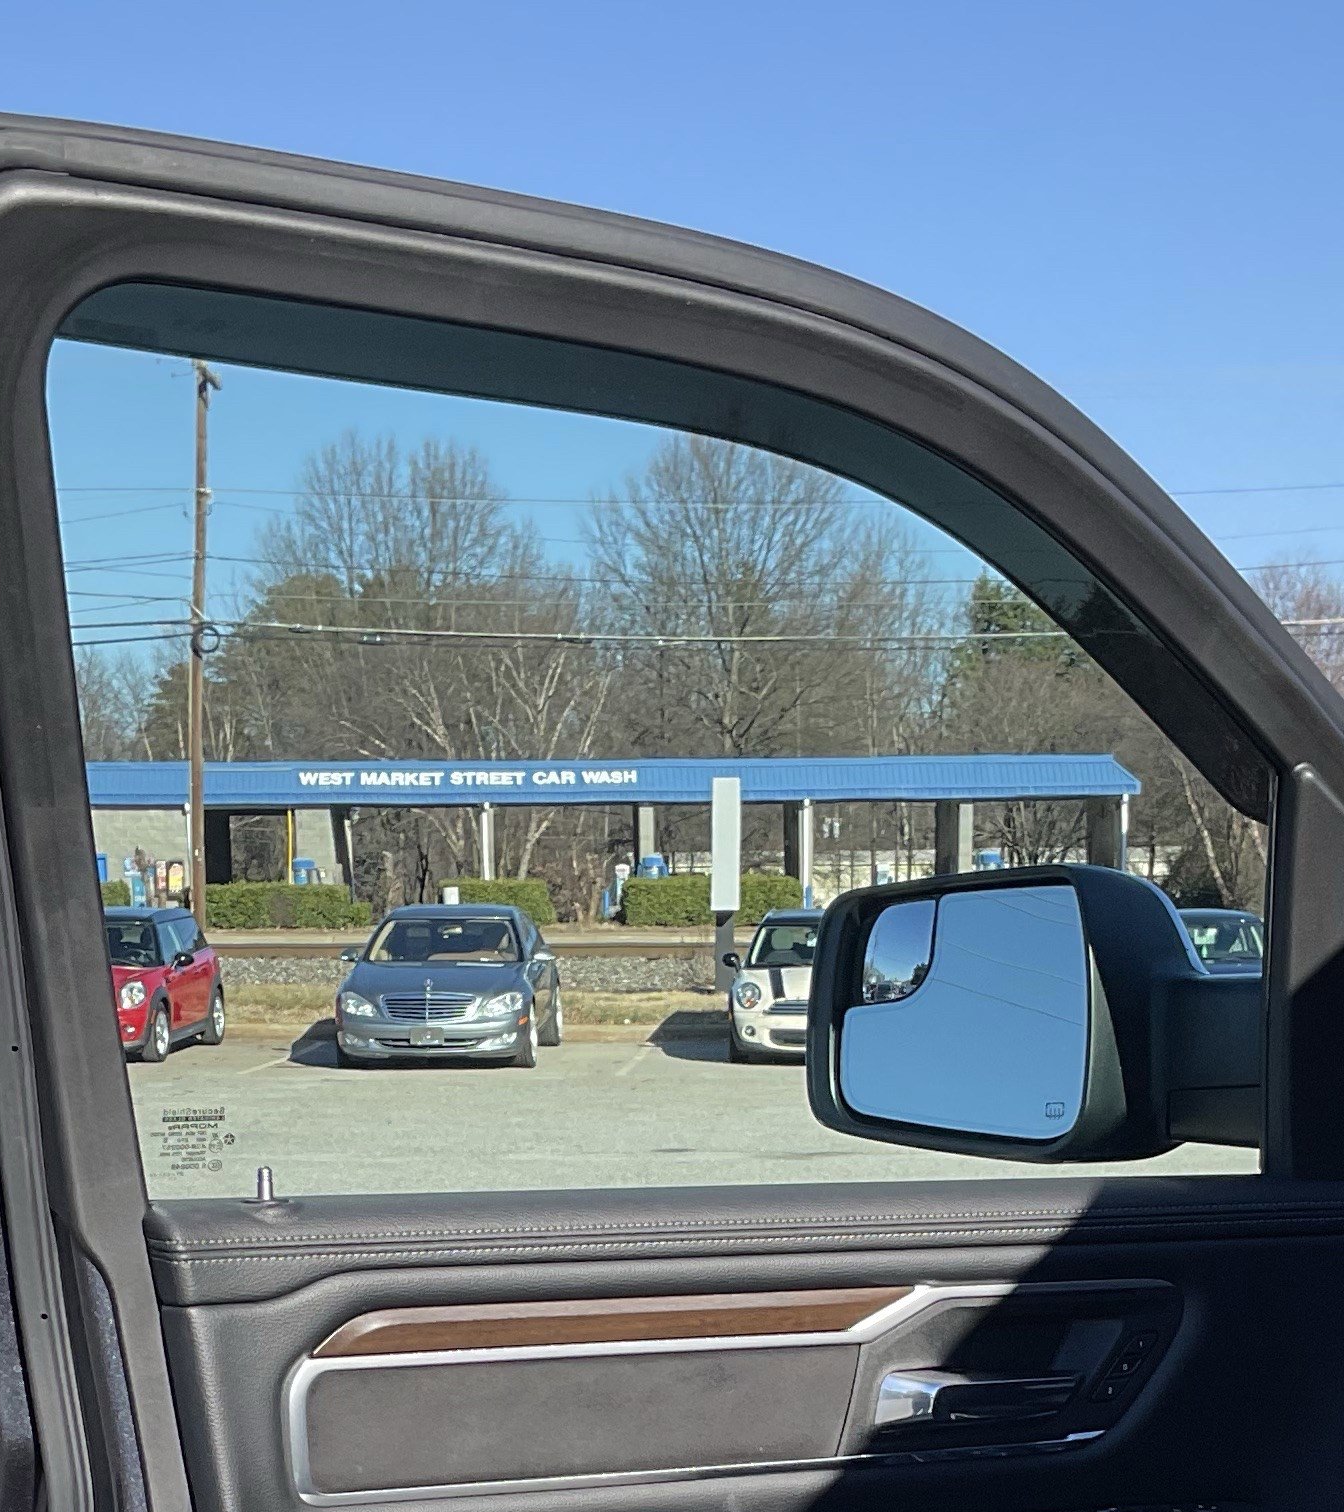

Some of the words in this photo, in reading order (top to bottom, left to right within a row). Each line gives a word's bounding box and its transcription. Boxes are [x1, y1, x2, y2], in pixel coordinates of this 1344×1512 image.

[298, 771, 355, 786] WEST
[360, 771, 444, 786] MARKET
[449, 771, 526, 786] STREET
[532, 770, 576, 785] CAR
[581, 769, 638, 784] WASH
